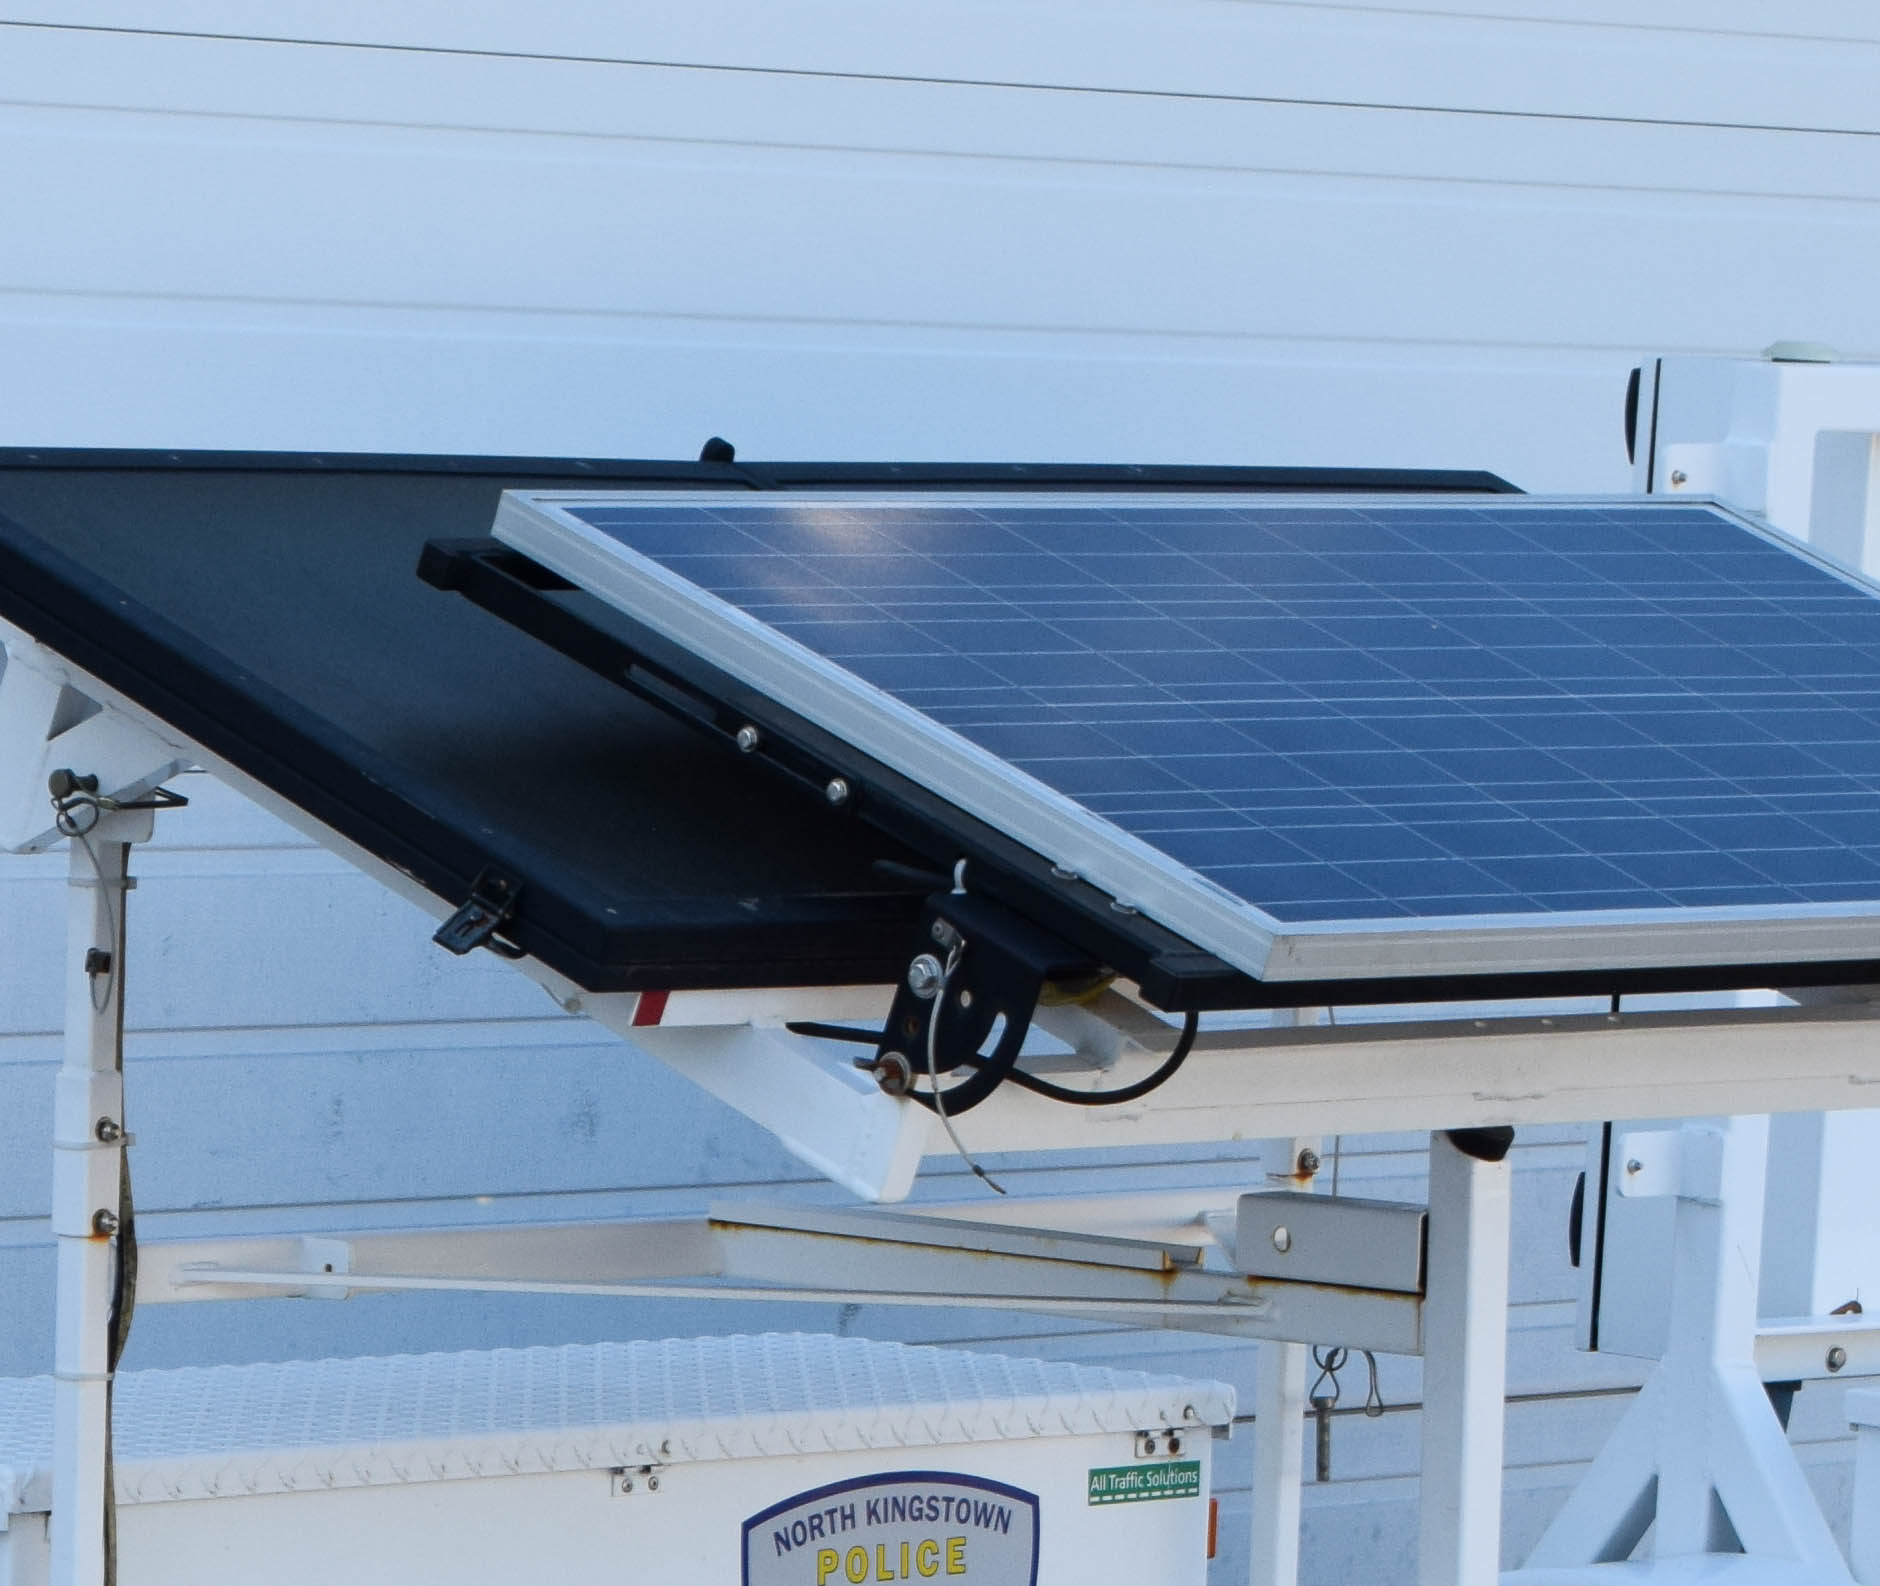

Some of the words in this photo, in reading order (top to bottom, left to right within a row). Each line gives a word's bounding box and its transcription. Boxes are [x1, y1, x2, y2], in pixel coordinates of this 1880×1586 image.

[1090, 1474, 1106, 1492] All
[1108, 1471, 1144, 1491] Traffic
[1145, 1468, 1199, 1488] Solutions
[772, 1502, 857, 1558] NORTH
[865, 1494, 1012, 1536] KINGSTOWN
